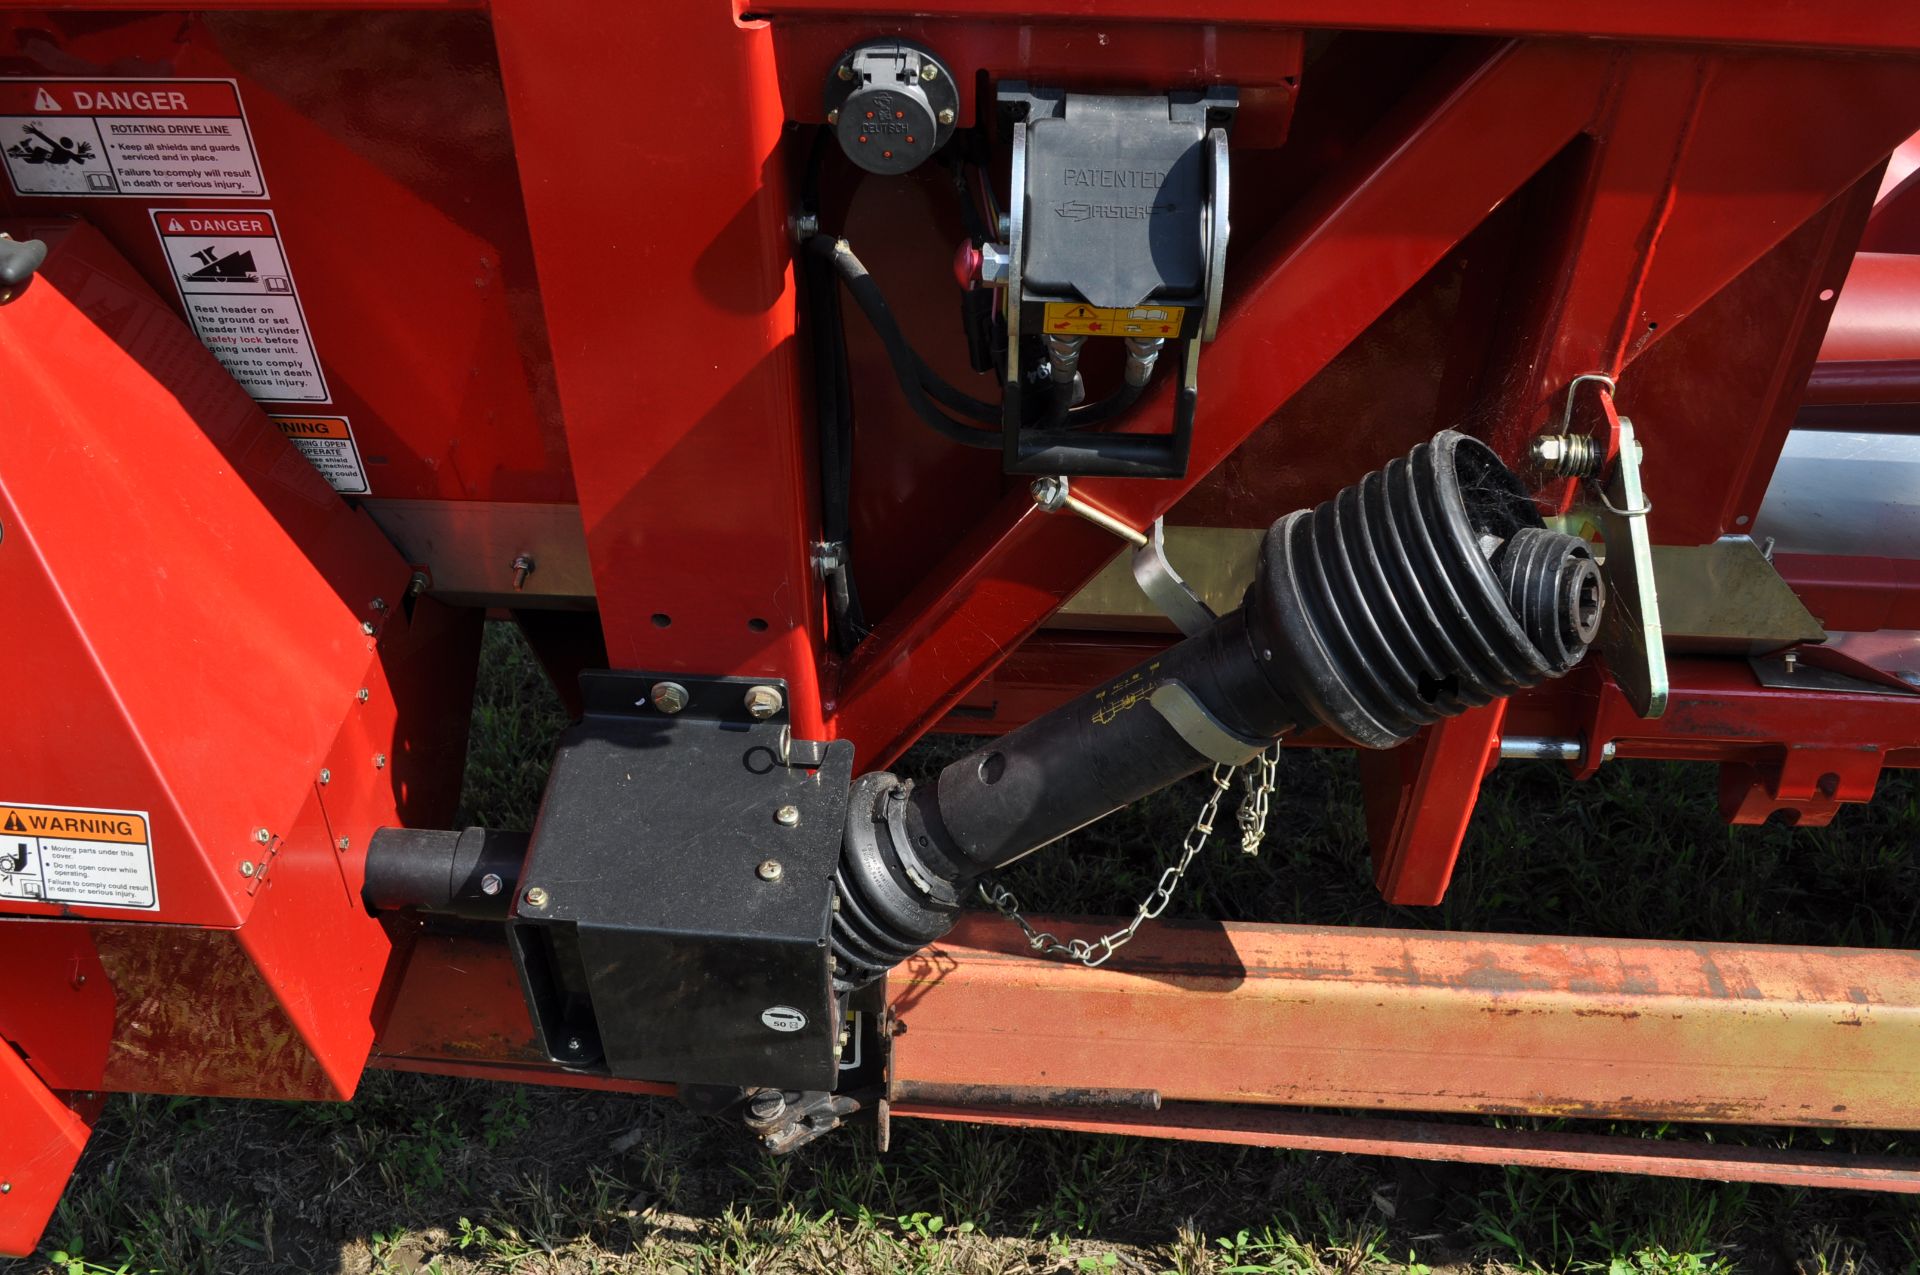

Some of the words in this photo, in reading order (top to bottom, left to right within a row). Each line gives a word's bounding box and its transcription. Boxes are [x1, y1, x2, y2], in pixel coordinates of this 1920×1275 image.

[73, 91, 188, 110] DANGER
[111, 125, 165, 134] ROTATING
[168, 125, 202, 134] DRIVE
[204, 126, 230, 134] LINE
[862, 122, 909, 133] DEUTSCH
[118, 143, 141, 152] Keep
[144, 143, 154, 151] all
[209, 144, 240, 152] guards
[122, 153, 159, 161] serviced
[192, 154, 218, 163] place.
[118, 168, 151, 176] Failure
[166, 169, 201, 178] comply
[204, 169, 221, 177] will
[1064, 167, 1167, 188] PATENTED
[176, 180, 212, 188] serious
[215, 181, 244, 189] injury.
[190, 219, 263, 232] DANGER
[194, 305, 219, 313] Rest
[221, 306, 256, 314] header
[218, 317, 254, 325] ground
[202, 325, 237, 333] header
[240, 326, 254, 334] lift
[258, 326, 299, 335] cylinder
[206, 336, 237, 344] safety
[265, 336, 298, 344] before
[209, 346, 239, 354] going
[275, 346, 298, 354] unit.
[265, 360, 303, 369] comply
[283, 369, 312, 377] death
[276, 379, 308, 388] injury.
[276, 423, 329, 434] NING
[29, 815, 132, 836] WARNING
[51, 845, 76, 853] Moving
[78, 847, 96, 855] parts
[120, 849, 134, 857] this
[54, 870, 89, 878] operating.
[81, 881, 106, 889] comply
[115, 890, 137, 898] injury.
